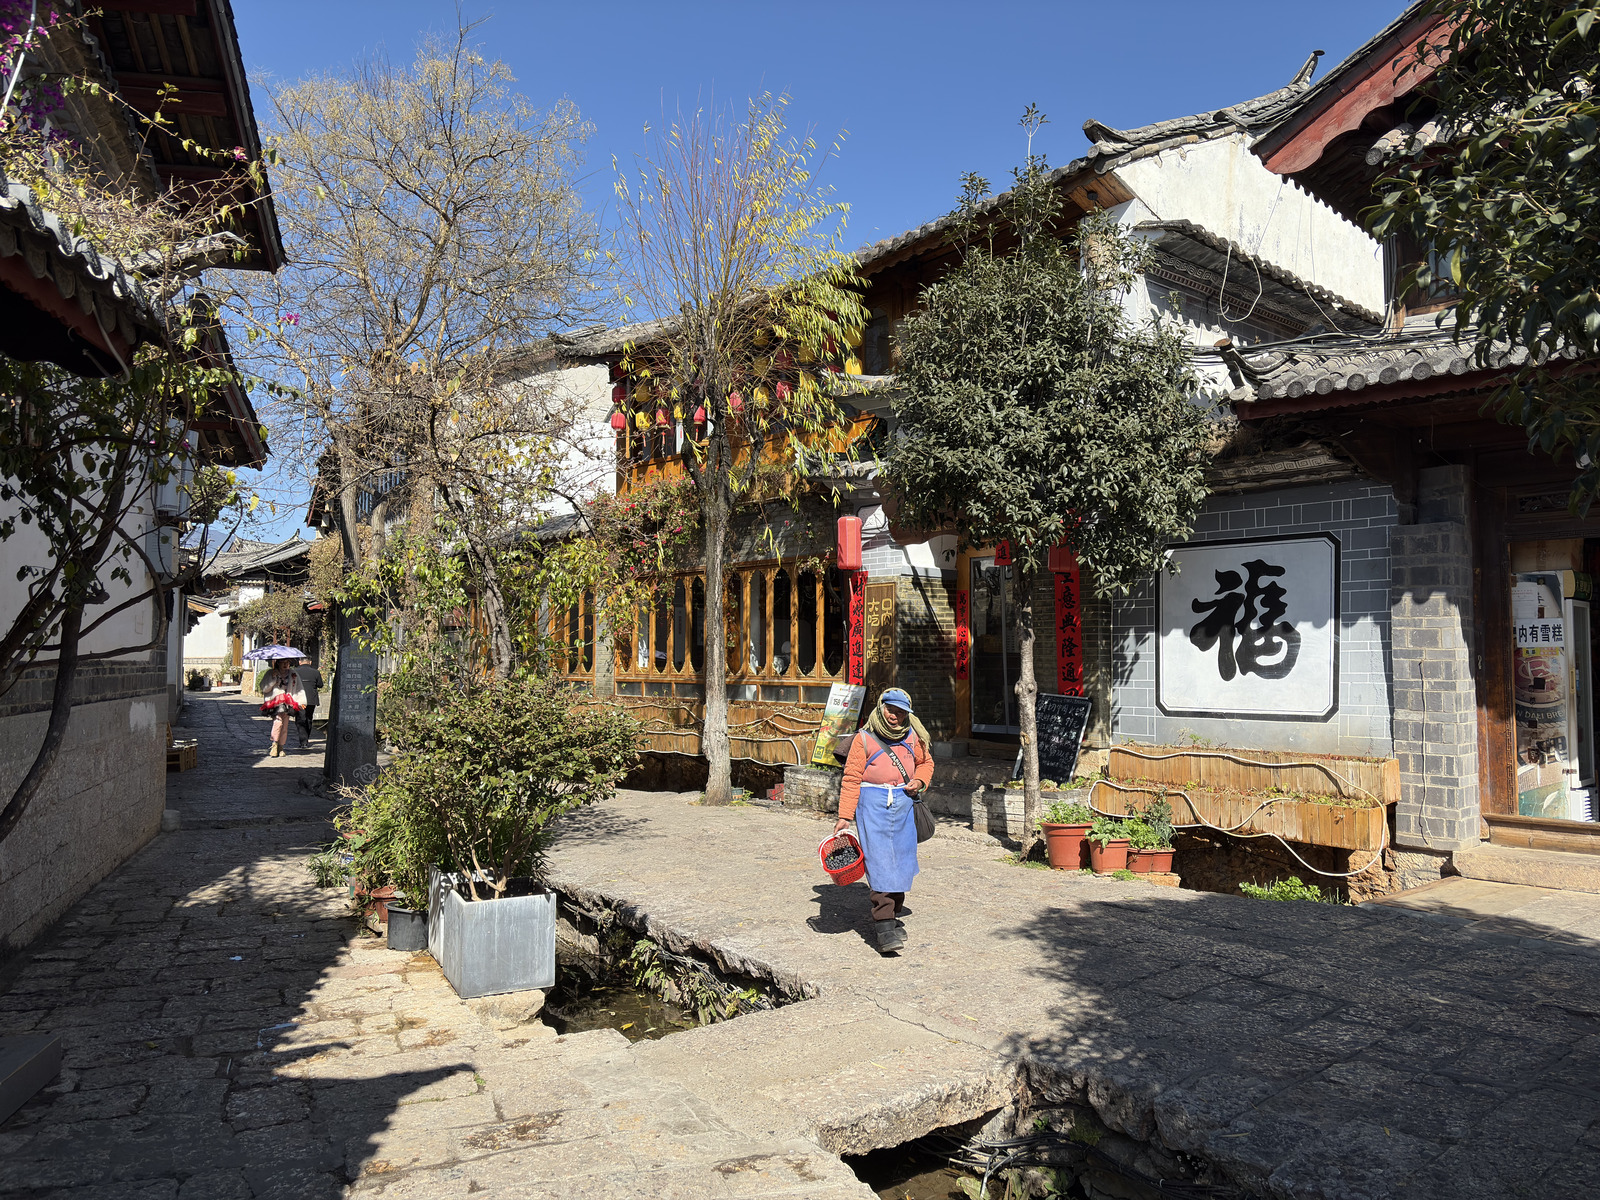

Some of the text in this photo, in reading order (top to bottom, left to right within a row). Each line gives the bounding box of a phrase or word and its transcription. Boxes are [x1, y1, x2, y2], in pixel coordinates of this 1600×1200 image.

[1189, 558, 1302, 682] 福
[1518, 623, 1564, 643] 内有雪糕
[888, 752, 907, 777] FASHION
